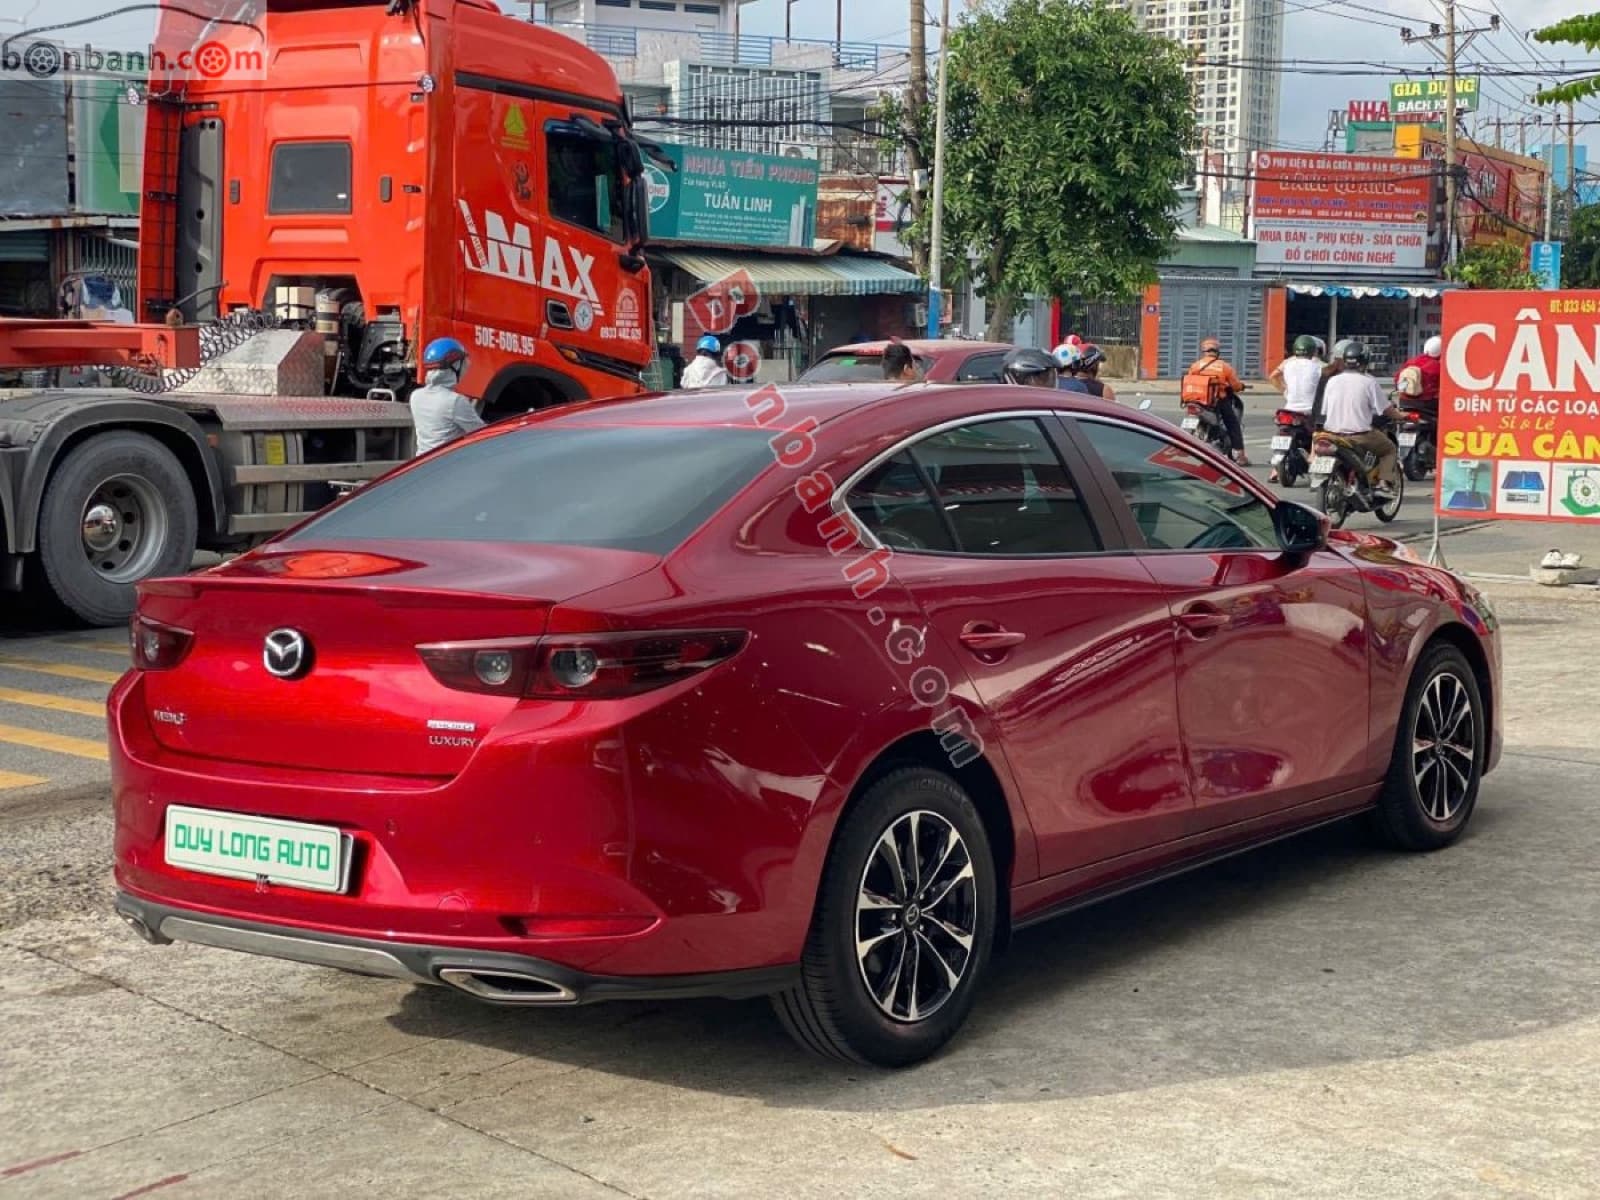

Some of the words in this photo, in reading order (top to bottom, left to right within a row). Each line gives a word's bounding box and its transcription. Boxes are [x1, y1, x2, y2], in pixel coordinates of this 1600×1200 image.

[1394, 82, 1422, 97] GIA
[704, 188, 740, 209] TUẤN
[744, 197, 773, 213] LINH
[1259, 230, 1282, 242] MUA
[1284, 229, 1306, 243] BÁN
[1316, 232, 1337, 246] PHỤ
[1339, 231, 1363, 246] KIỆN
[1396, 233, 1422, 247] CHỮA
[1446, 308, 1600, 392] CÂN
[1454, 394, 1492, 417] ĐIỆN
[1496, 393, 1517, 413] TỬ
[1520, 394, 1560, 414] CÁC
[1443, 425, 1521, 457] SỬA
[1533, 430, 1600, 460] CÂN
[428, 735, 477, 748] LUXURY
[174, 823, 213, 851] DUY
[219, 831, 270, 862] LONG
[277, 839, 330, 871] AUTO
